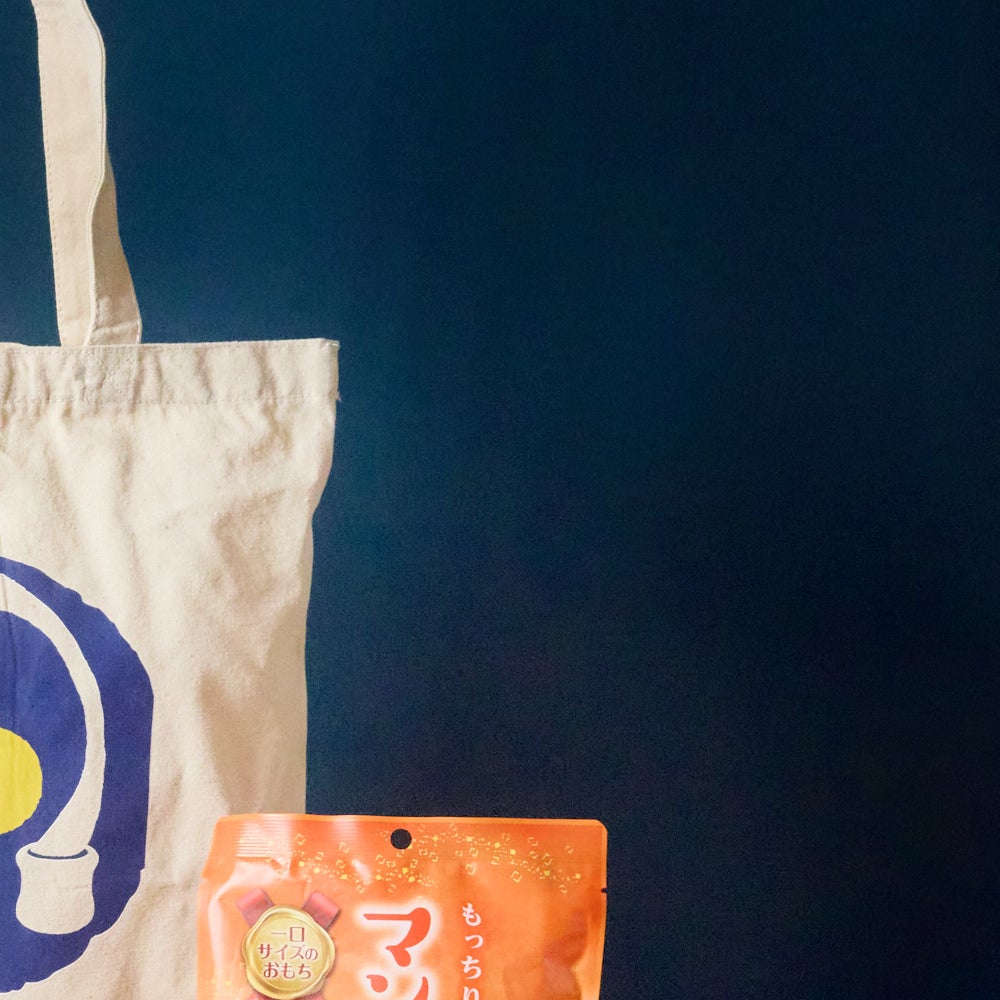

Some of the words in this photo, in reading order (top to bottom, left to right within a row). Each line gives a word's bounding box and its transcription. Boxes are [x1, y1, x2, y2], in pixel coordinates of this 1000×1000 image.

[270, 927, 305, 944] 一口
[257, 943, 318, 962] サイズの
[263, 961, 312, 980] おもち
